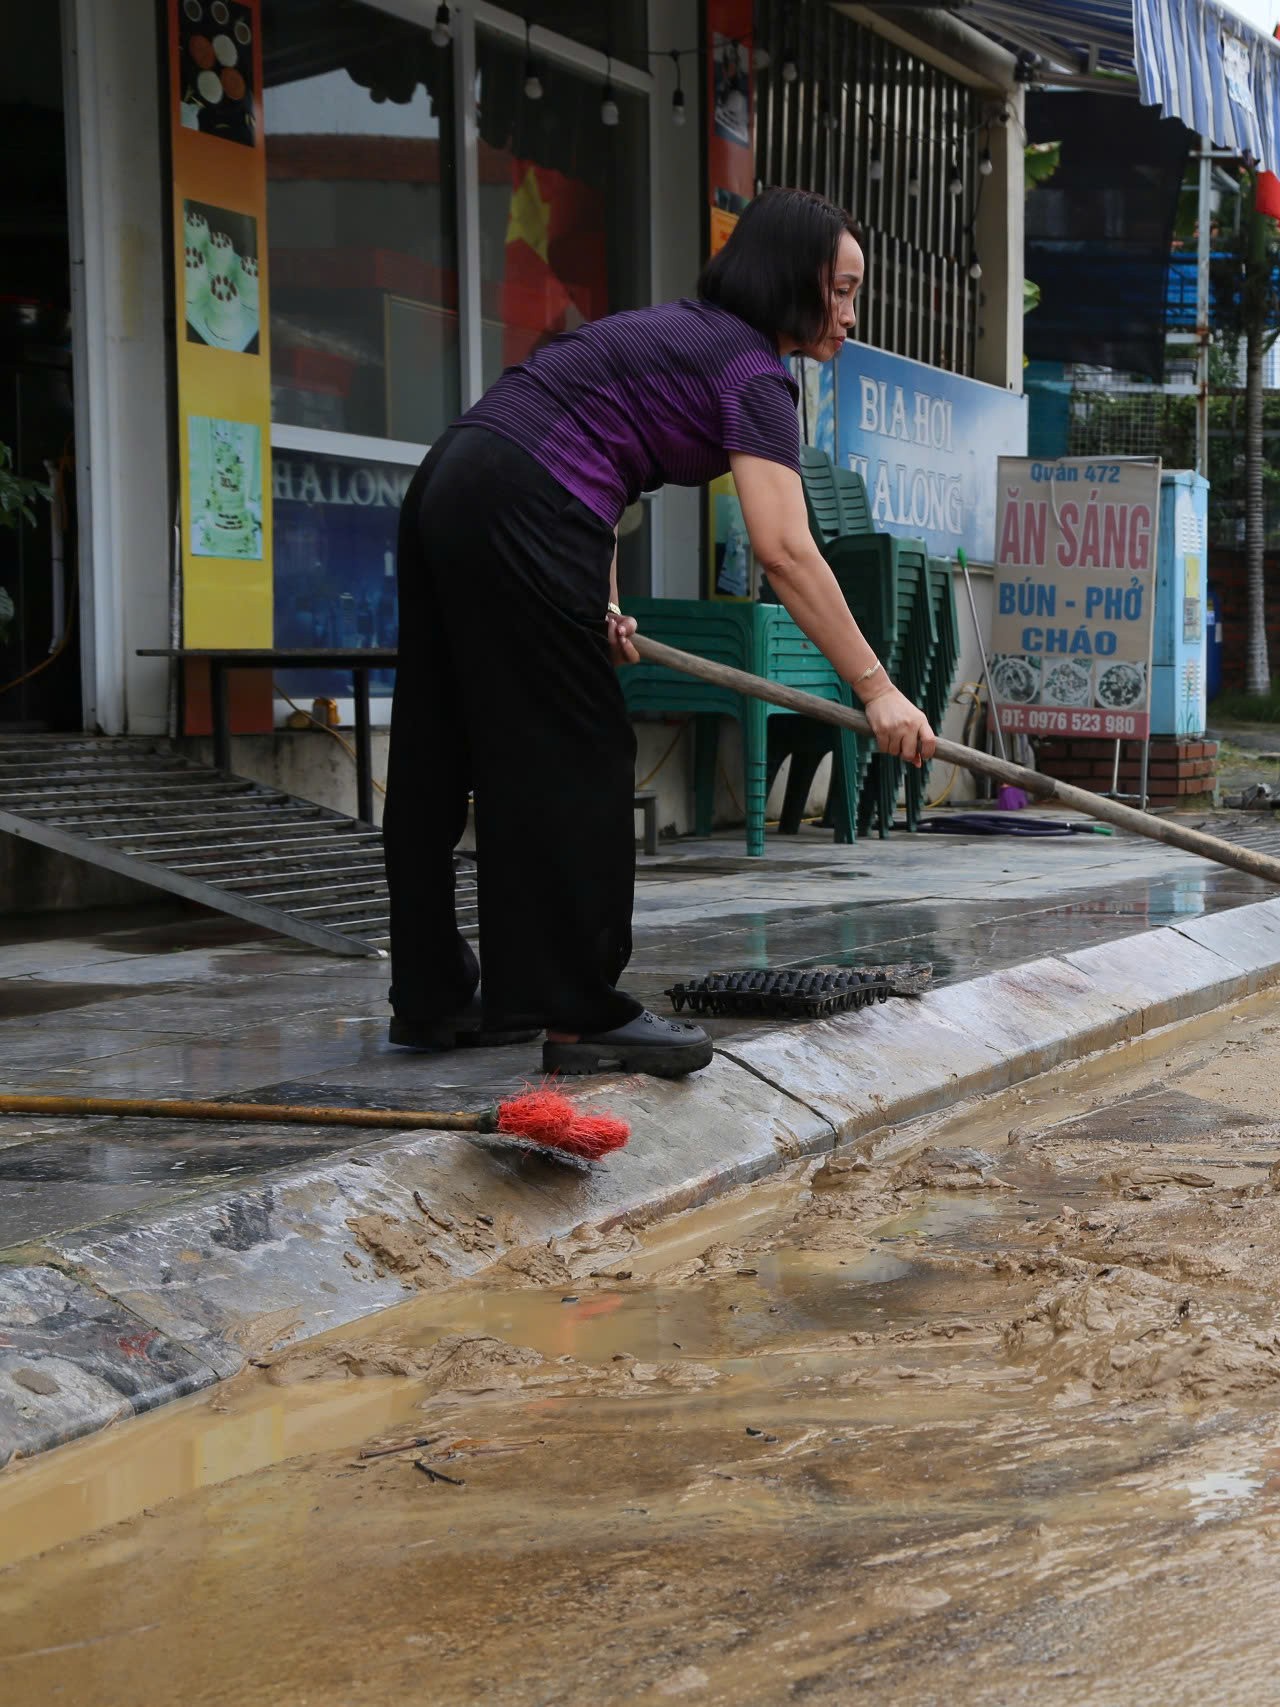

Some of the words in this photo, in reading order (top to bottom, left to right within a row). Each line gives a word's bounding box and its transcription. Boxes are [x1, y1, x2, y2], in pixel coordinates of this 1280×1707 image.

[859, 375, 910, 441] BIA
[1084, 465, 1121, 483] 472
[999, 487, 1048, 566] ĂN
[1056, 489, 1150, 570] SÁNG
[999, 577, 1057, 617] BÚN
[1085, 576, 1144, 621] PHỞ
[1021, 625, 1117, 656] CHÁO
[1002, 709, 1024, 727] ĐT:
[1029, 710, 1067, 730] 0976
[1071, 714, 1101, 732] 523
[1105, 716, 1135, 734] 980
